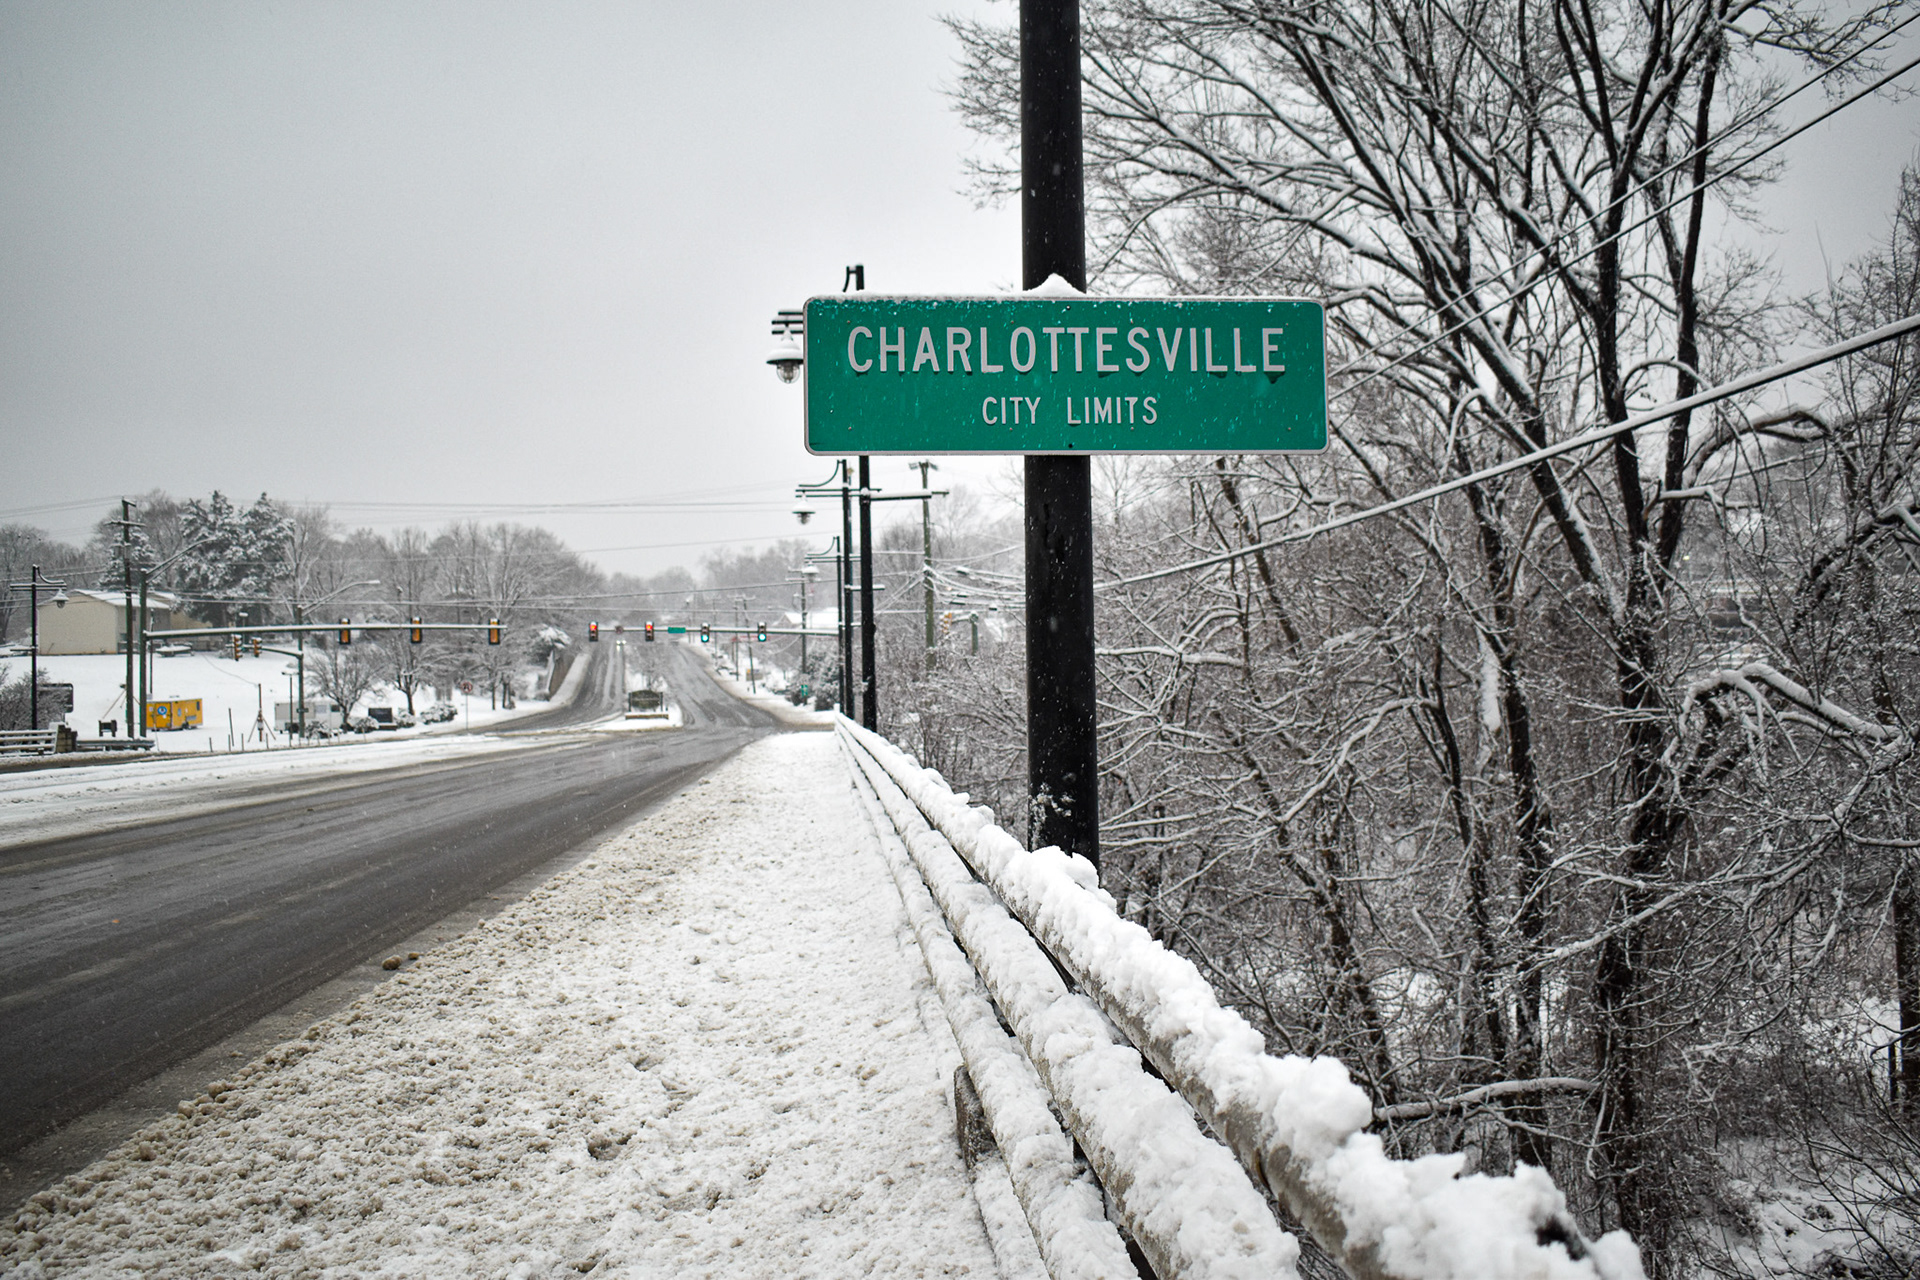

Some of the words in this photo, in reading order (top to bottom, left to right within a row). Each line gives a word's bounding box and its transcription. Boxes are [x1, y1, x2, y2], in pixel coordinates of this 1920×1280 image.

[847, 326, 1287, 373] CHARLOTTESVILLE
[982, 396, 1042, 425] CITY
[1066, 396, 1158, 425] LIMITS
